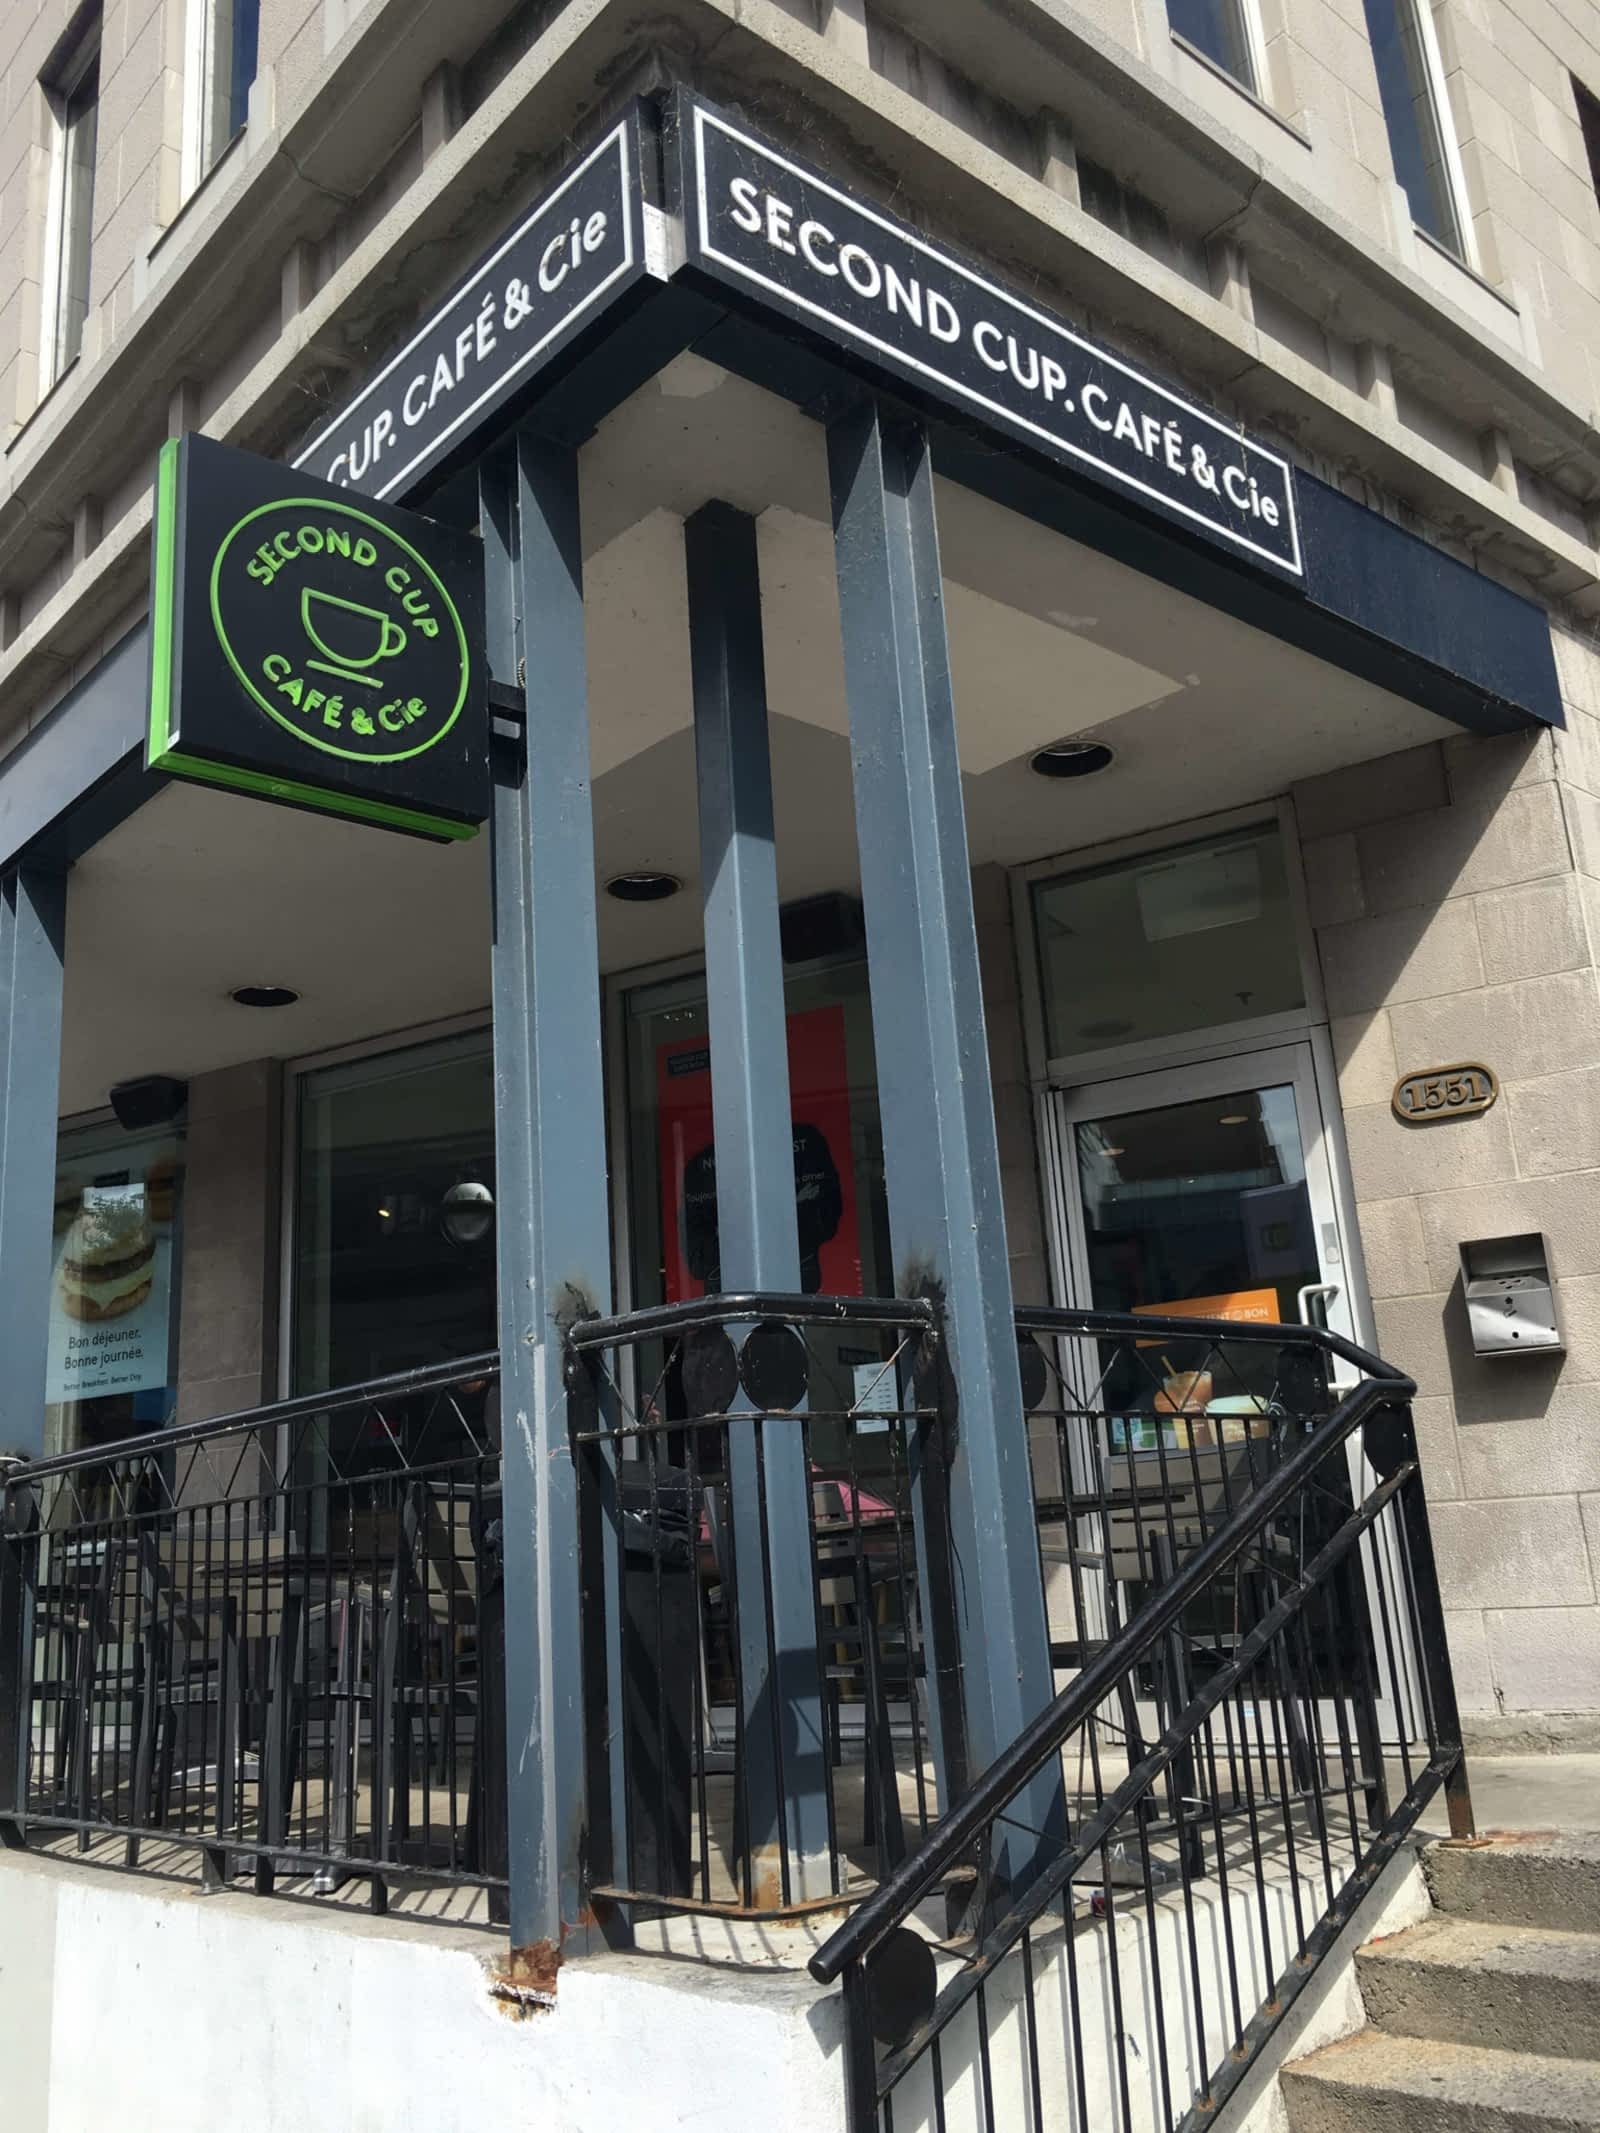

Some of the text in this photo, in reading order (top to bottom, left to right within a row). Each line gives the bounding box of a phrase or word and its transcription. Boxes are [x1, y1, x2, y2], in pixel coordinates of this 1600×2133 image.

[403, 291, 497, 426] CAFÉ
[503, 278, 534, 330] &
[538, 210, 607, 292] Cie
[729, 178, 961, 344] SECOND
[1081, 383, 1186, 475] CAFÉ
[1191, 443, 1221, 495] &
[1223, 466, 1280, 526] Cie
[246, 525, 440, 637] SECOND CUP
[262, 654, 428, 736] CAFÉ & Cie
[1405, 1071, 1488, 1112] 1551
[64, 1354, 98, 1370] Bonne
[68, 1336, 90, 1350] Bon
